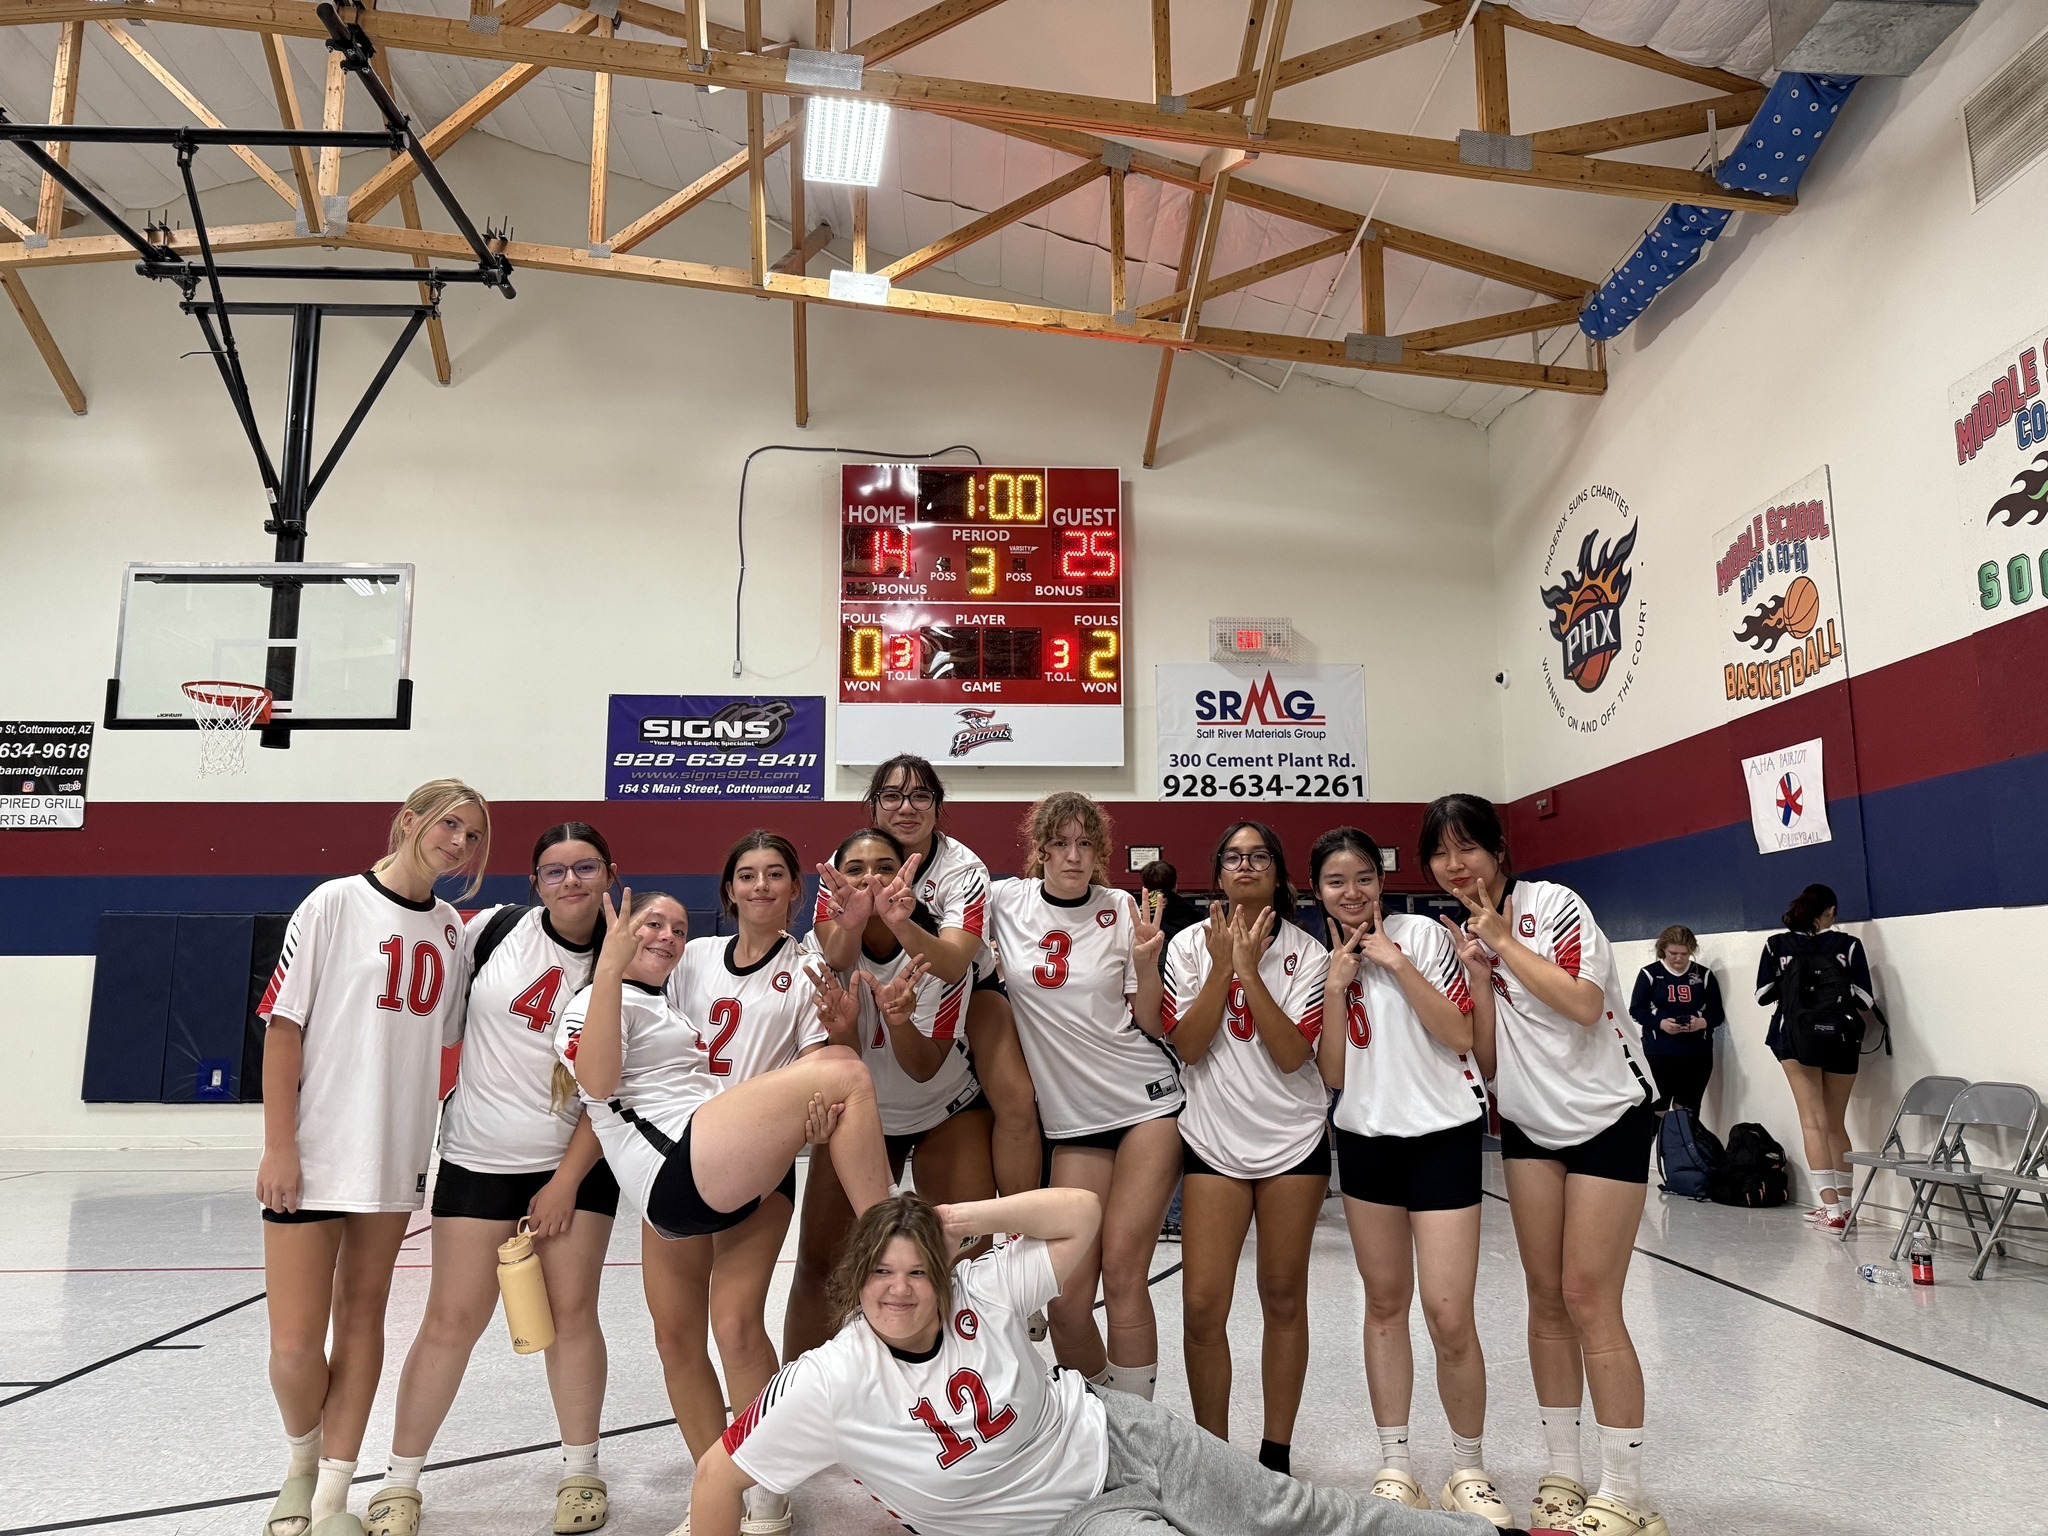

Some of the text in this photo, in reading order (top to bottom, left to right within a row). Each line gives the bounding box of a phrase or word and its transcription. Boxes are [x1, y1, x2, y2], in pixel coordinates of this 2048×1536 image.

[1954, 347, 2040, 466] MIDDLE
[968, 473, 1042, 521] 1:00
[848, 505, 906, 524] HOME
[1052, 508, 1116, 527] GUEST
[952, 530, 1010, 542] PERIOD
[1544, 484, 1629, 576] PHOENIX SUNS CHARITIES
[873, 530, 909, 573] 14
[1062, 530, 1117, 577] 25
[1716, 499, 1830, 596] MIDDLE SCHOOL
[930, 572, 957, 582] POSS
[969, 546, 996, 595] 3
[1005, 572, 1032, 583] POSS
[1740, 540, 1809, 605] BOYS & CO-ED
[878, 584, 928, 595] BONUS
[1035, 585, 1084, 597] BONUS
[842, 613, 887, 625] FOULS
[955, 614, 1006, 625] PLAYER
[1074, 615, 1119, 627] FOULS
[1564, 609, 1617, 668] PHX
[852, 627, 881, 678] 0
[894, 637, 911, 668] 3
[1053, 638, 1070, 669] 3
[1089, 630, 1118, 679] 2
[1724, 618, 1842, 701] BASKETBALL
[886, 671, 917, 681] T.O.L.
[1542, 599, 1647, 733] WINNING ON AND OFF THE COURT
[844, 681, 881, 692] WON
[1045, 672, 1076, 682] T.O.L.
[961, 682, 1002, 693] GAME
[1081, 682, 1118, 693] WON
[1195, 669, 1316, 725] SRMG
[5, 724, 17, 736] St,
[18, 724, 77, 735] Cottonwood,
[78, 725, 92, 734] AZ
[643, 719, 770, 739] SIGNS
[1196, 728, 1326, 741] Salt River Materials Group
[671, 740, 686, 748] Sign
[693, 740, 721, 748] Graphic
[953, 729, 1010, 750] Patriots
[613, 753, 818, 767] 928-639-9411
[1169, 753, 1356, 768] 300 Cement Plant Rd.
[1749, 748, 1807, 779] AHA PATRIOT
[631, 770, 799, 782] www.signs928.com
[1163, 774, 1364, 798] 928-634-2261
[618, 784, 811, 795] 154 S Main Street, Cottonwood AZ
[44, 797, 82, 809] GRILL
[30, 814, 58, 826] BAR
[1774, 831, 1823, 849] VOLLEYBALL
[1032, 929, 1073, 990] 3
[376, 934, 445, 1017] 10
[509, 966, 565, 1033] 4
[1667, 984, 1692, 1003] 19
[1226, 977, 1255, 1043] 9
[1346, 979, 1373, 1050] 6
[709, 997, 743, 1076] 2
[908, 1367, 1018, 1470] 12
